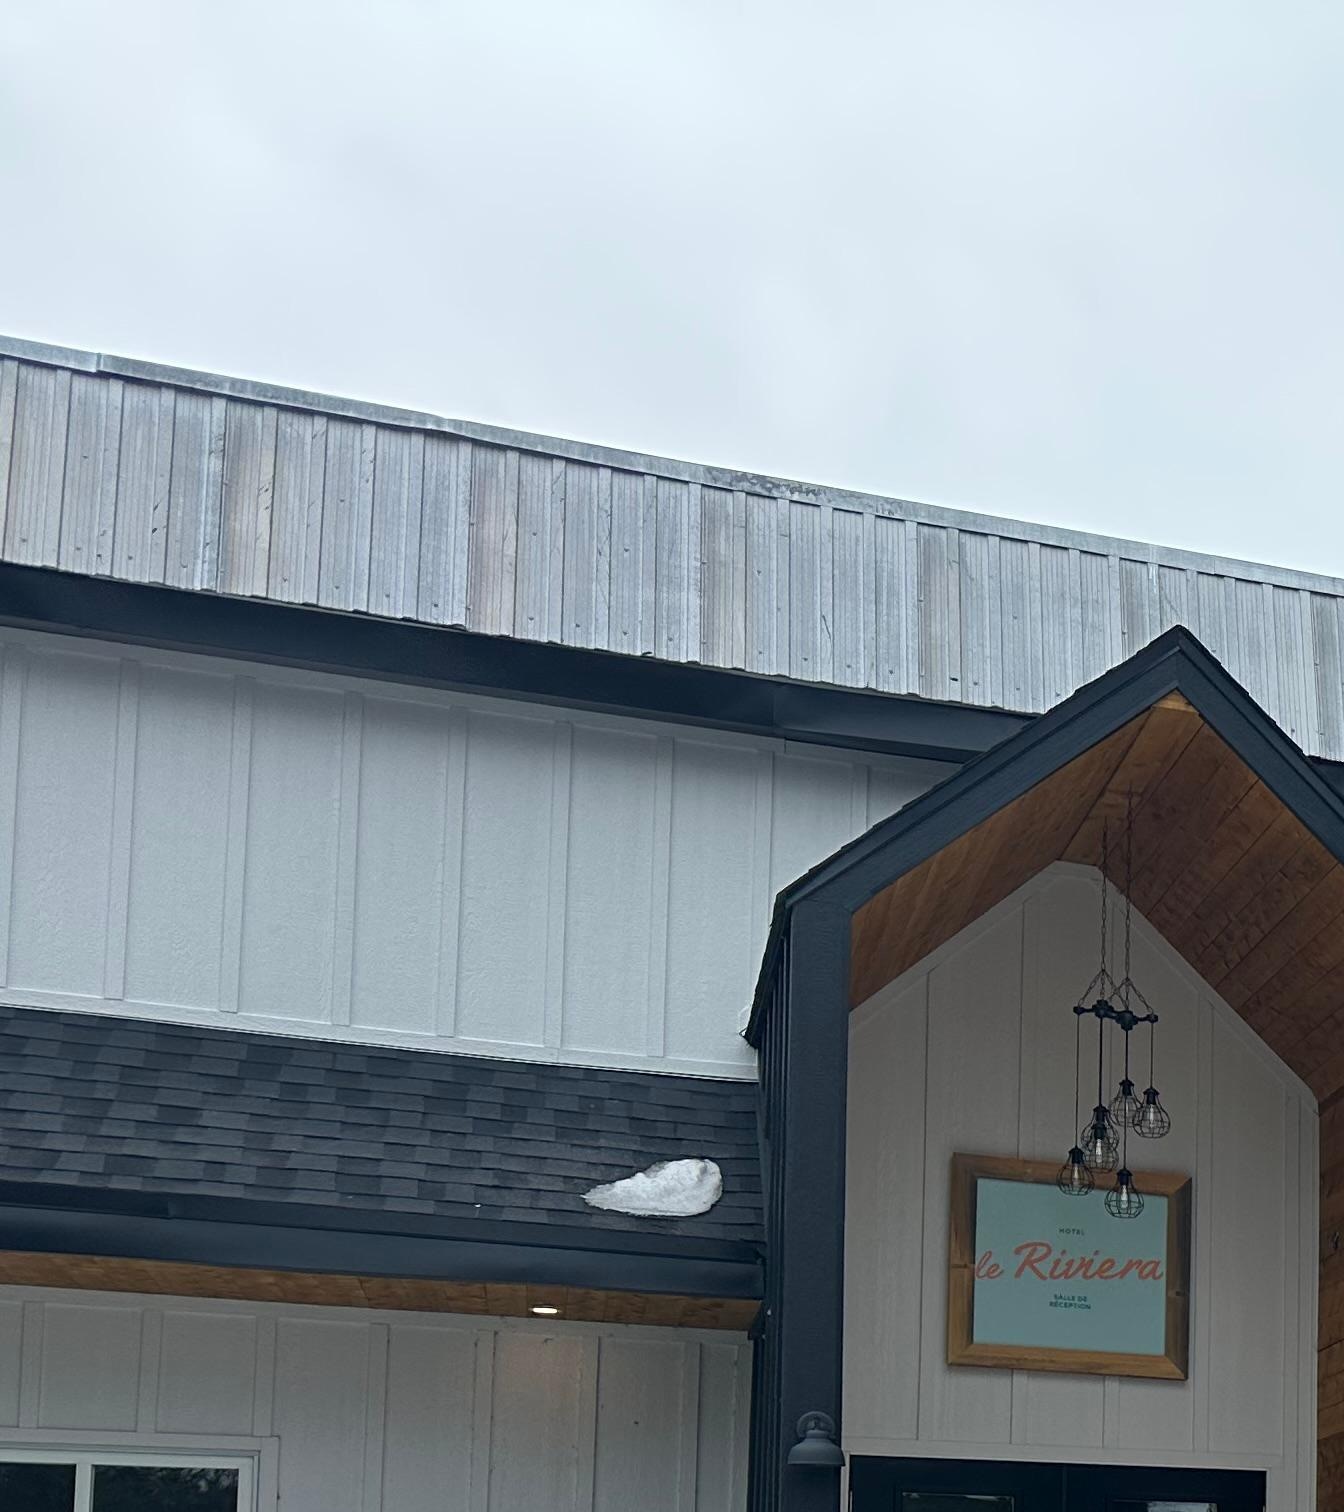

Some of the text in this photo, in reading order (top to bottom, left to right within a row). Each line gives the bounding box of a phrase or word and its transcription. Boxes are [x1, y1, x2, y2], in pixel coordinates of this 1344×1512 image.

[1059, 1228, 1085, 1236] HOTEL
[975, 1241, 1164, 1281] le Riviera
[1054, 1293, 1088, 1303] SALLE DE
